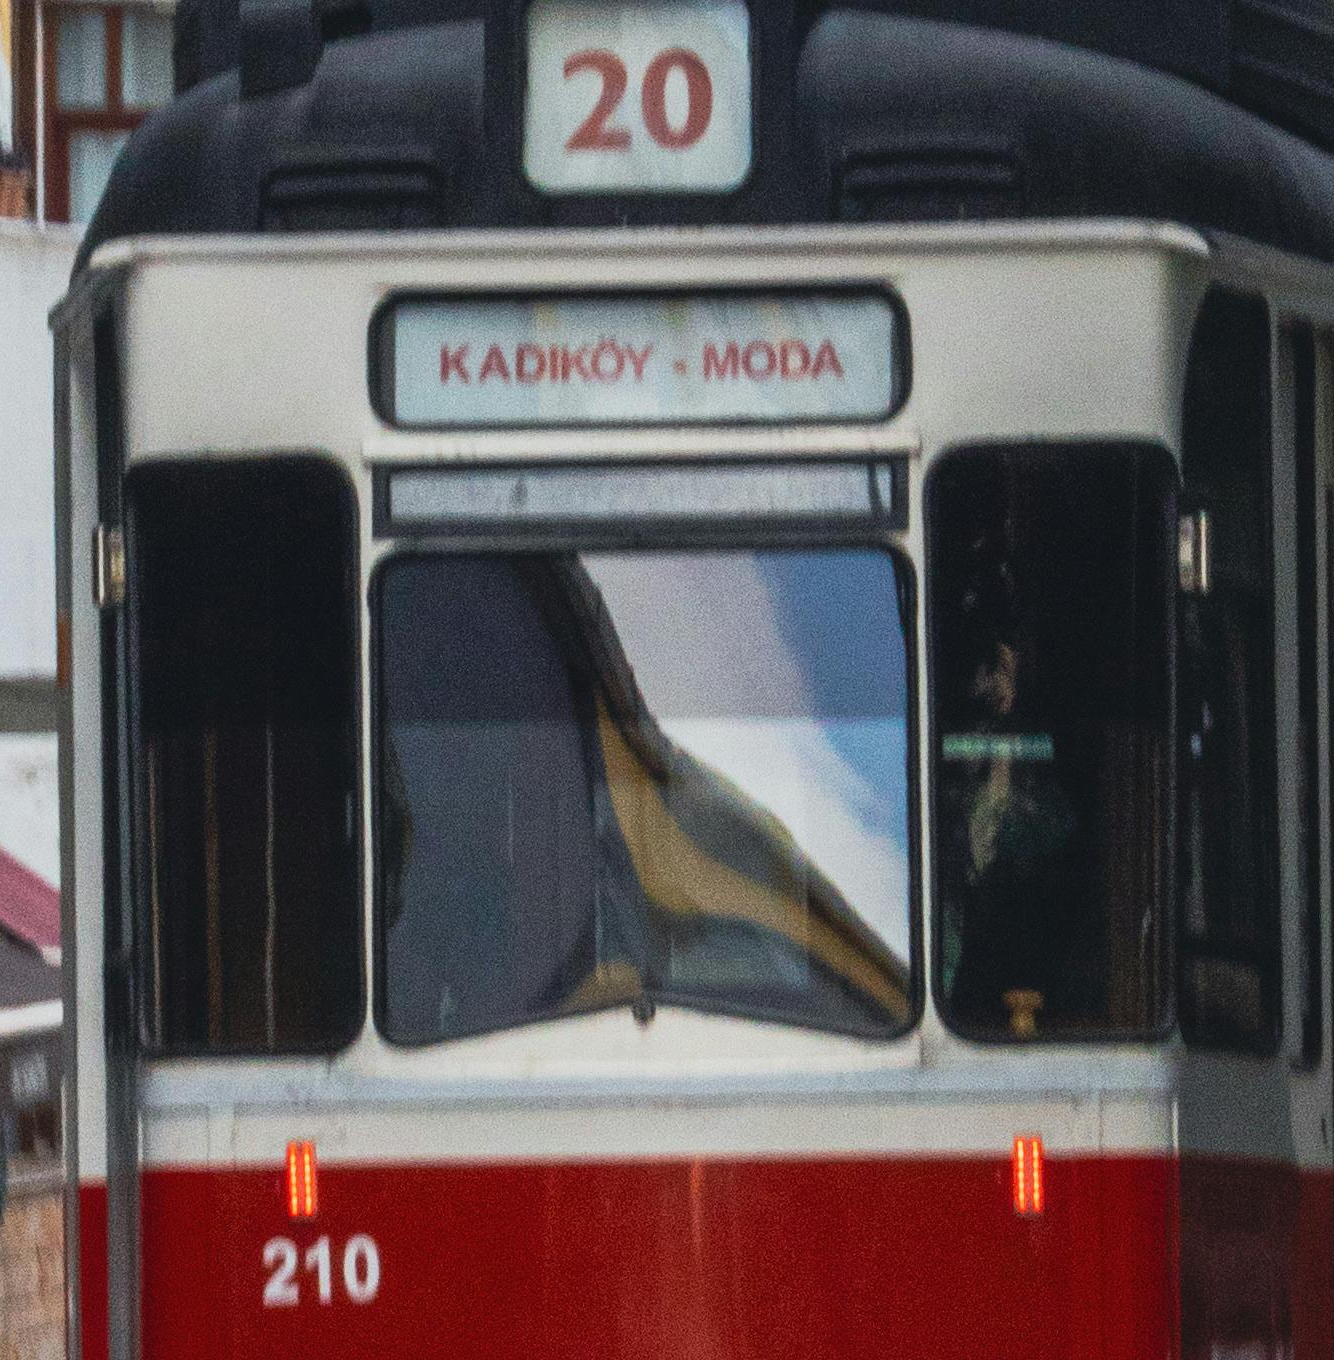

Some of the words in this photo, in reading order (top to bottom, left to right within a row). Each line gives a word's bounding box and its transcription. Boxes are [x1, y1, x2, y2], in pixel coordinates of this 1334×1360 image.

[562, 46, 713, 153] 20
[438, 336, 653, 386] KADIKÖY
[703, 337, 844, 382] MODA
[263, 1234, 380, 1307] 210
